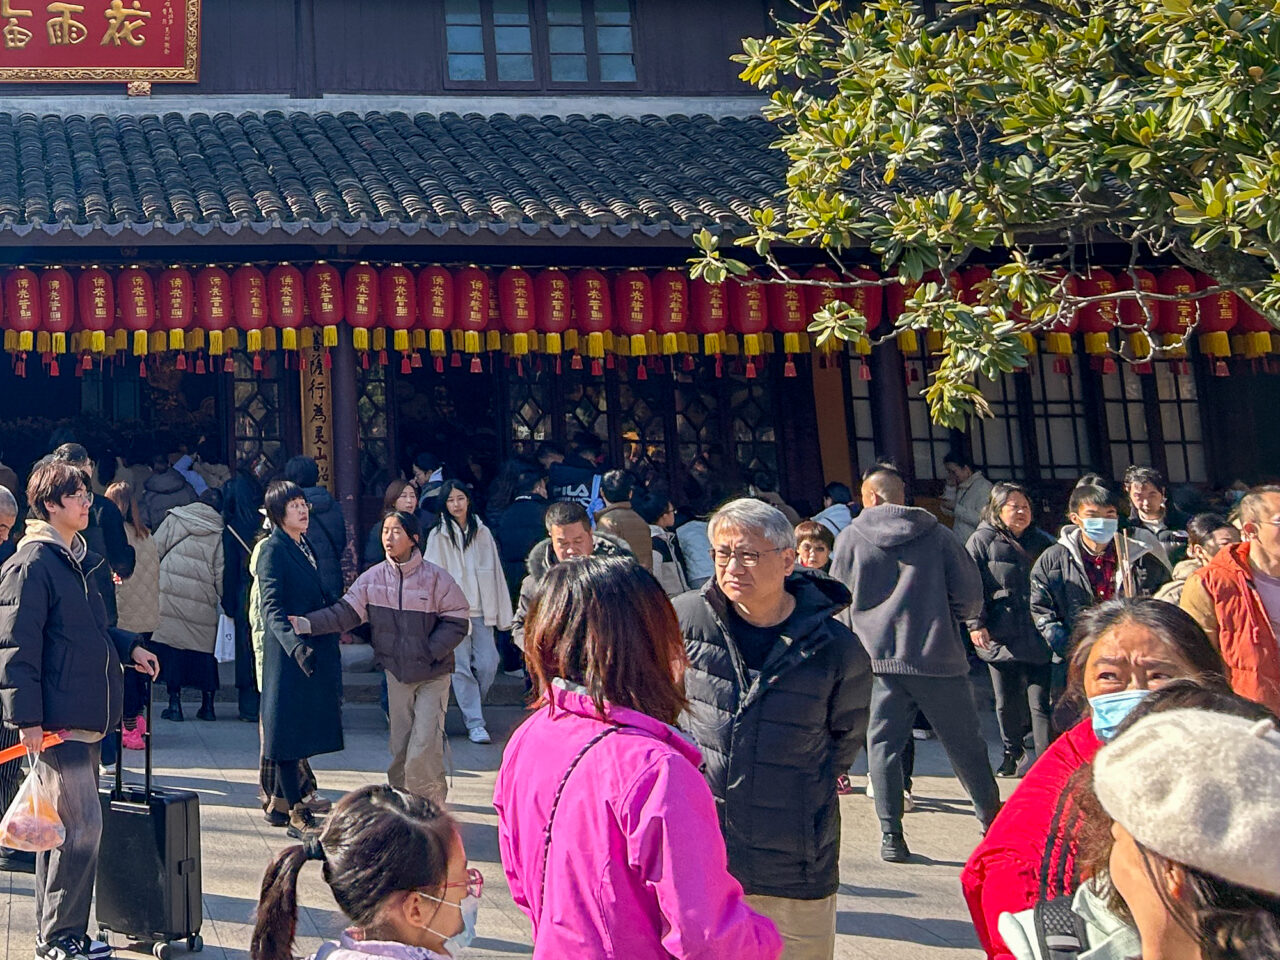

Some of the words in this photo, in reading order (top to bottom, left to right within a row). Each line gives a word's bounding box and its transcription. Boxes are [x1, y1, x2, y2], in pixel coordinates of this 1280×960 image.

[16, 279, 33, 320] 佛光普照
[48, 280, 63, 321] 佛光普照
[91, 277, 108, 318] 佛光普照
[131, 276, 149, 317] 佛光普照
[169, 278, 185, 319] 佛光普照
[208, 276, 225, 318] 佛光普照
[249, 278, 264, 318] 佛光普照
[280, 275, 295, 318] 佛光普照
[317, 273, 335, 313] 佛光普照
[355, 274, 370, 315] 佛光普照
[393, 275, 409, 317] 佛光普照
[431, 276, 446, 317] 佛光普照
[469, 280, 484, 322] 佛光普照
[512, 278, 529, 319] 佛光普照
[550, 279, 565, 321] 佛光普照
[587, 279, 604, 321] 佛光普照
[629, 280, 644, 322] 佛光普照
[669, 280, 683, 322] 佛光普照
[709, 283, 723, 319] 光普照
[1176, 285, 1192, 325] 佛普照
